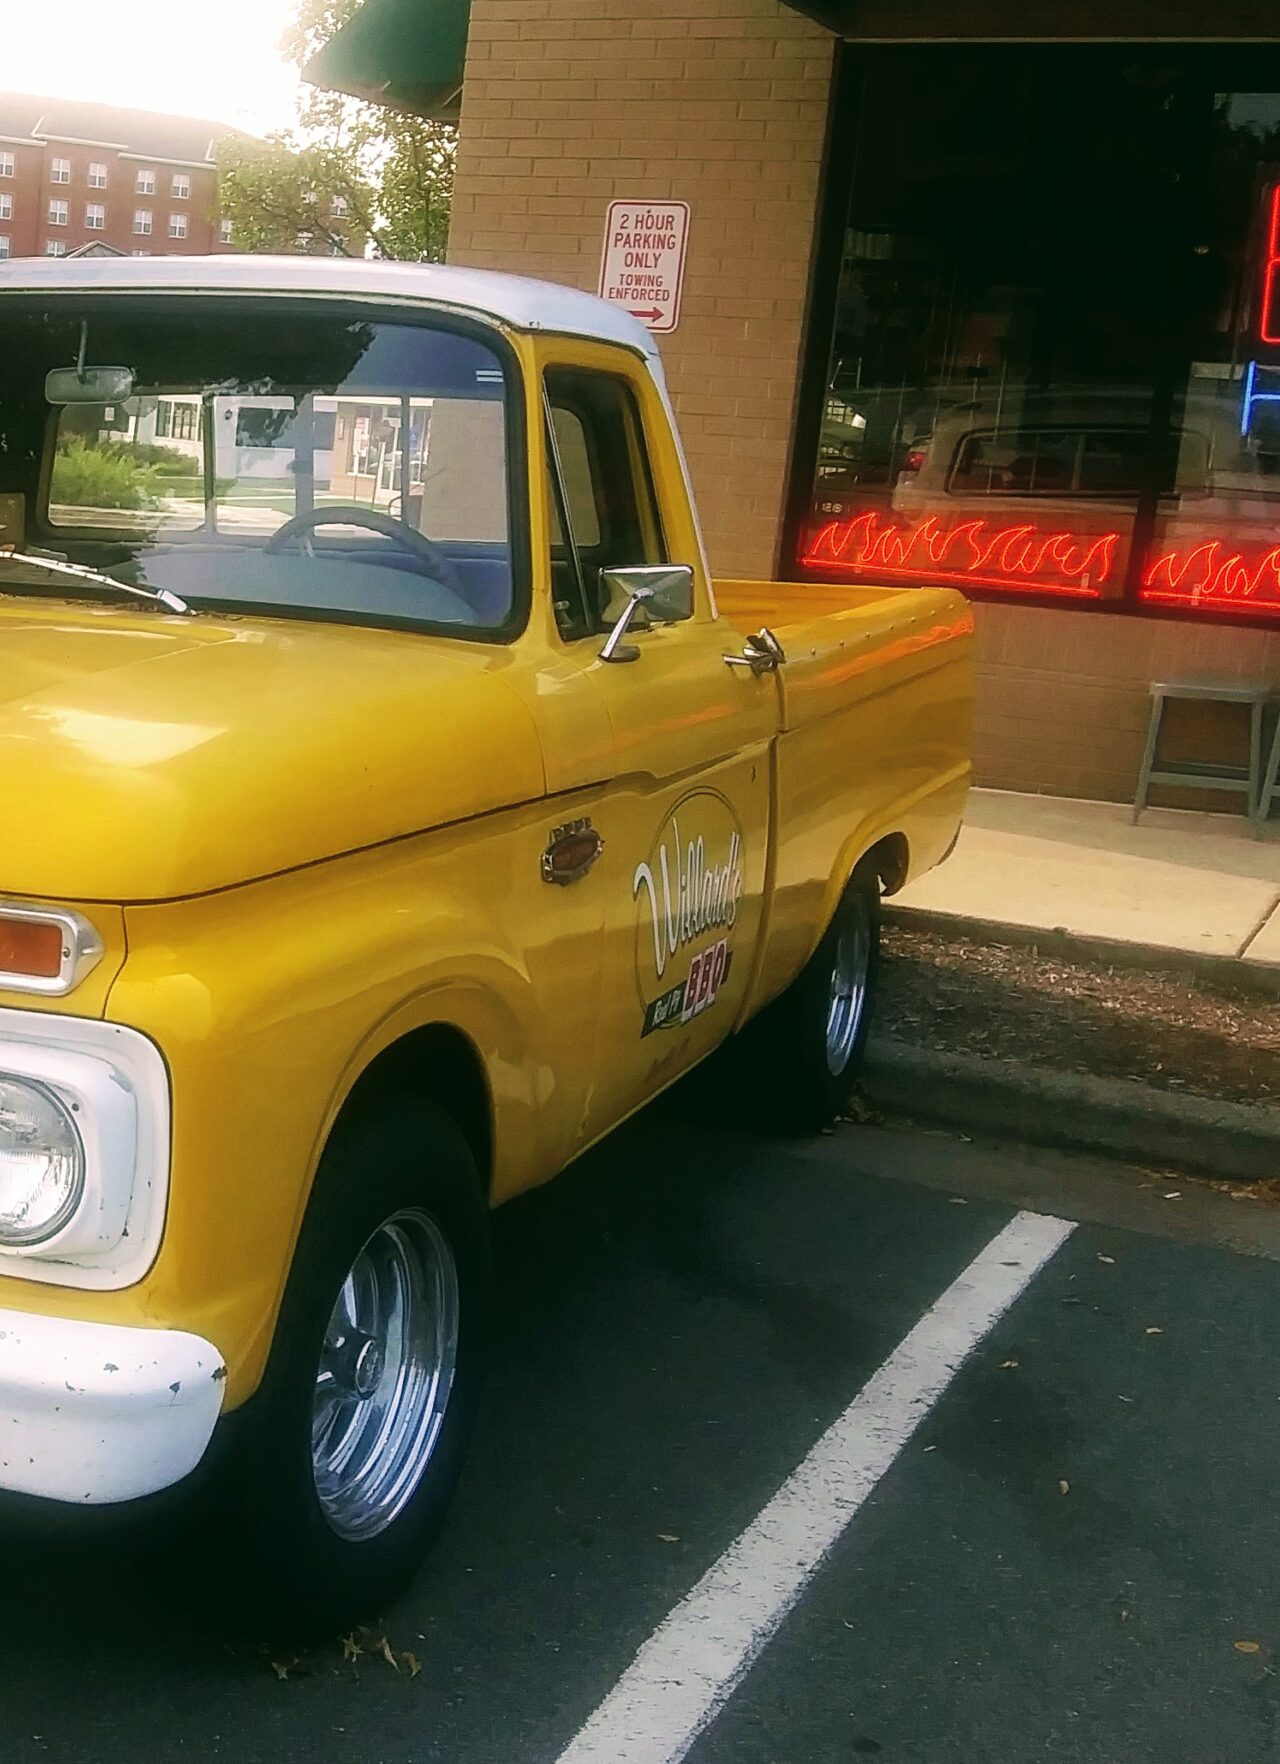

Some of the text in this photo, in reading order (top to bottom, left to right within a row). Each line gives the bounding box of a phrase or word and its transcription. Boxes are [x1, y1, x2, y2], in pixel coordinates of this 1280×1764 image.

[620, 213, 675, 231] 2 HOUR
[613, 232, 676, 250] PARKING
[624, 252, 662, 269] ONLY
[619, 273, 664, 287] TOWING
[608, 287, 670, 302] ENFORCED
[633, 817, 742, 977] Willard's
[682, 940, 727, 1024] BBQ
